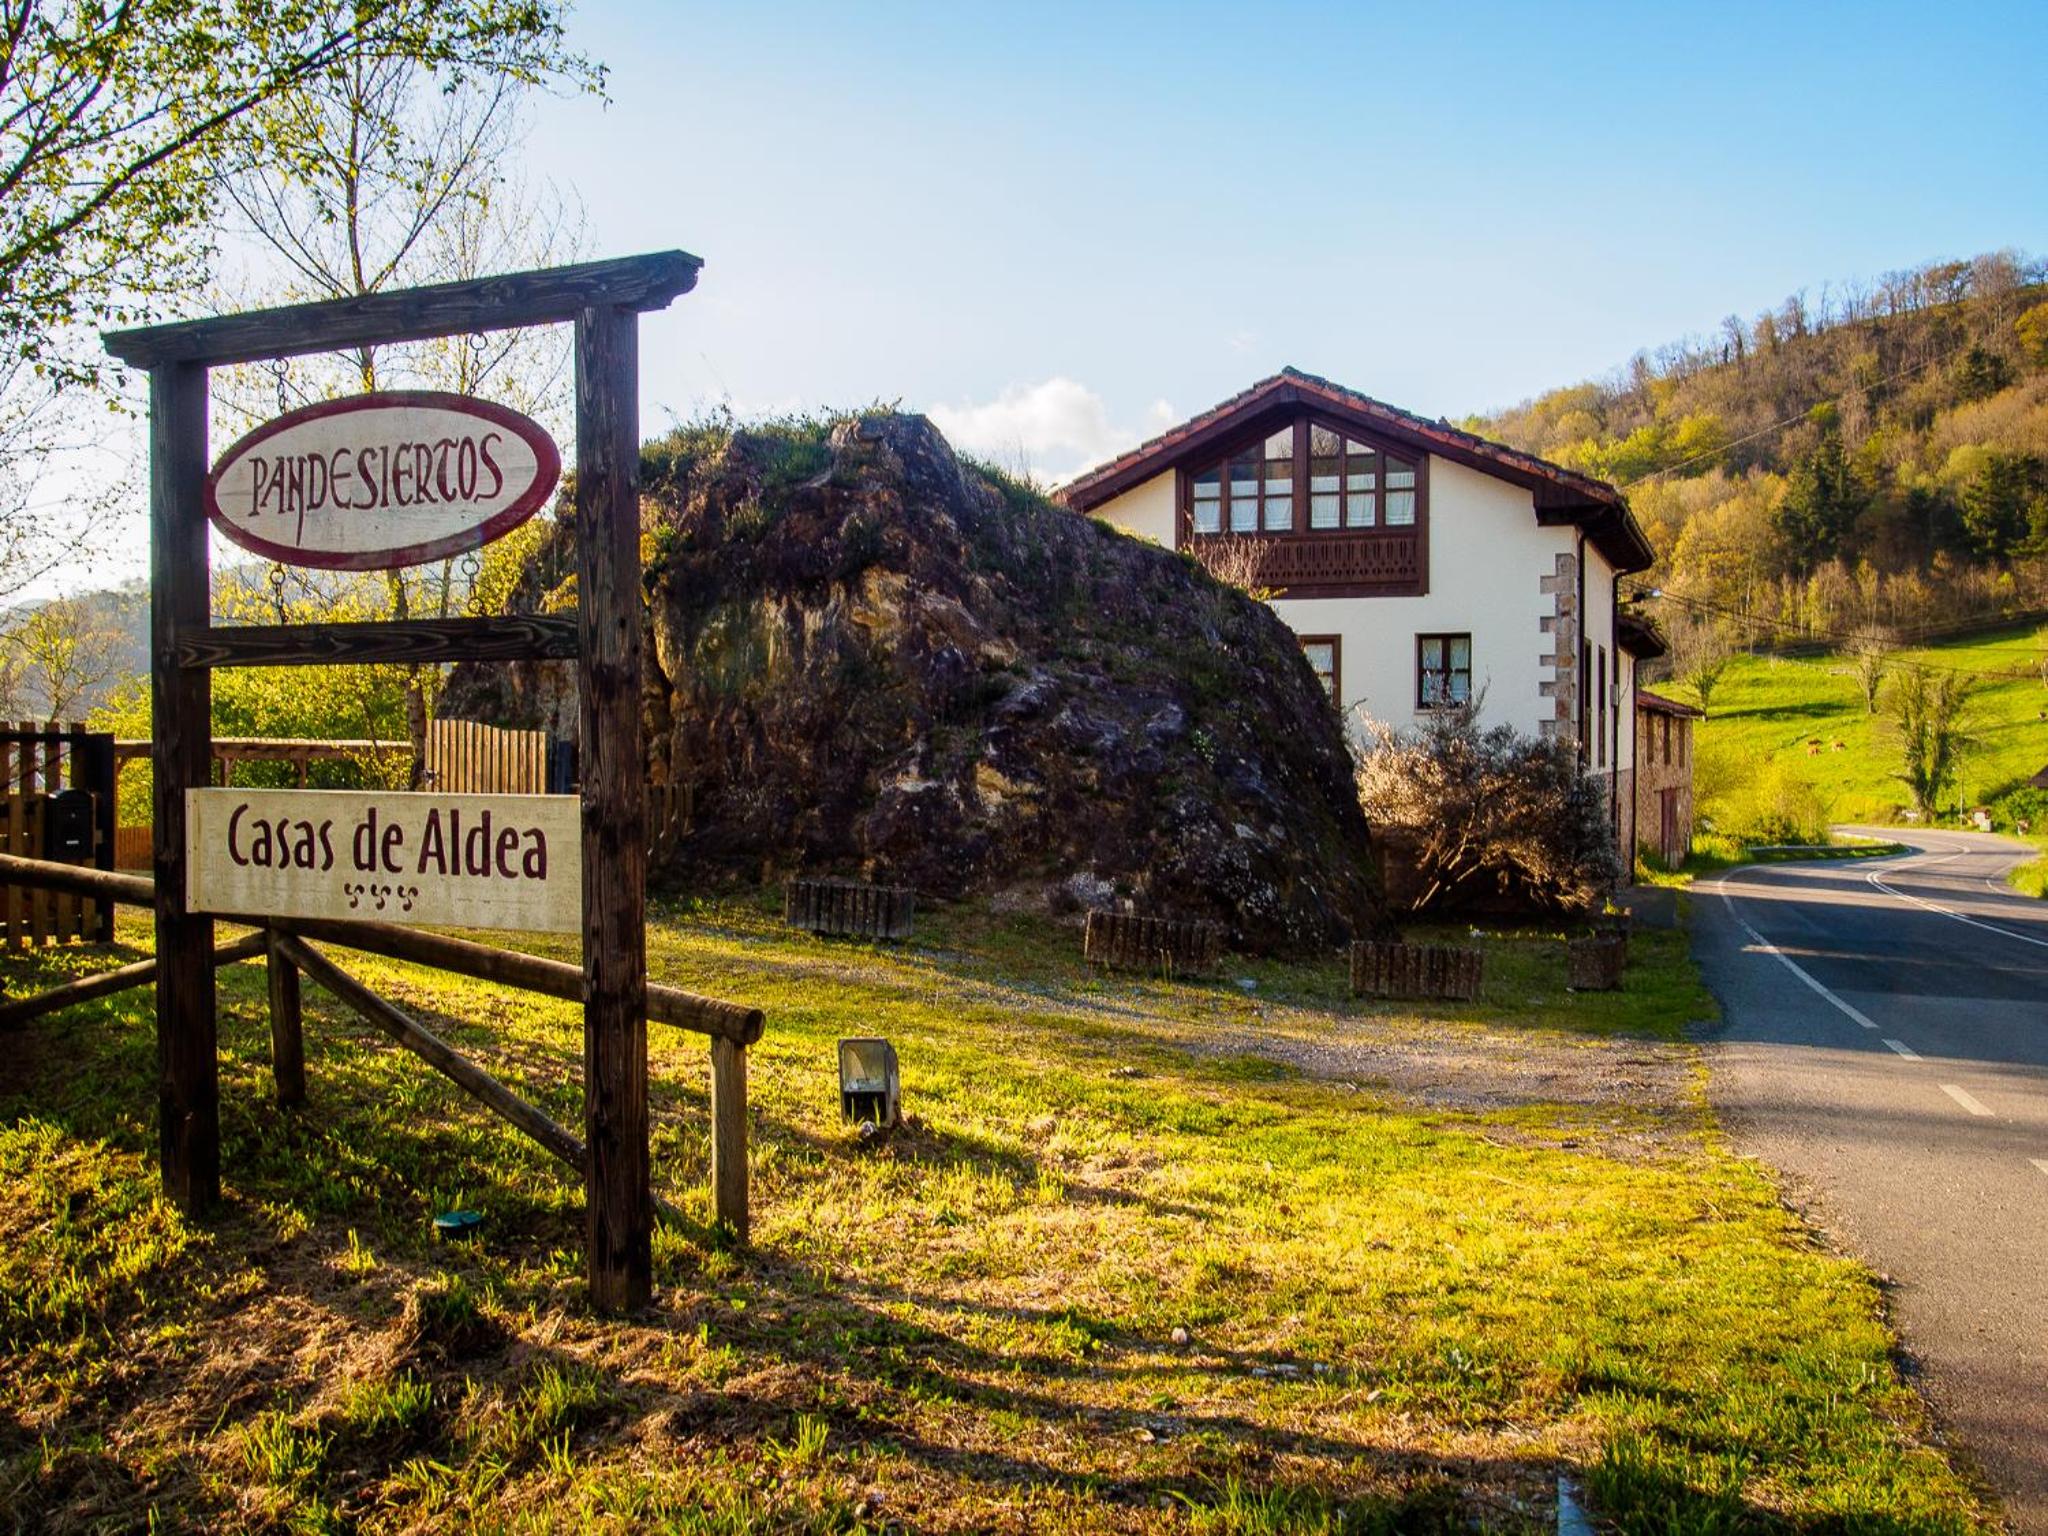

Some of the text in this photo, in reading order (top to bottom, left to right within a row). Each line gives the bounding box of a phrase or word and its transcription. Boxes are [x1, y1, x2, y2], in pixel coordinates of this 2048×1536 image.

[248, 432, 504, 546] PANDESIERTOS
[228, 803, 548, 880] Casas de Aldea
